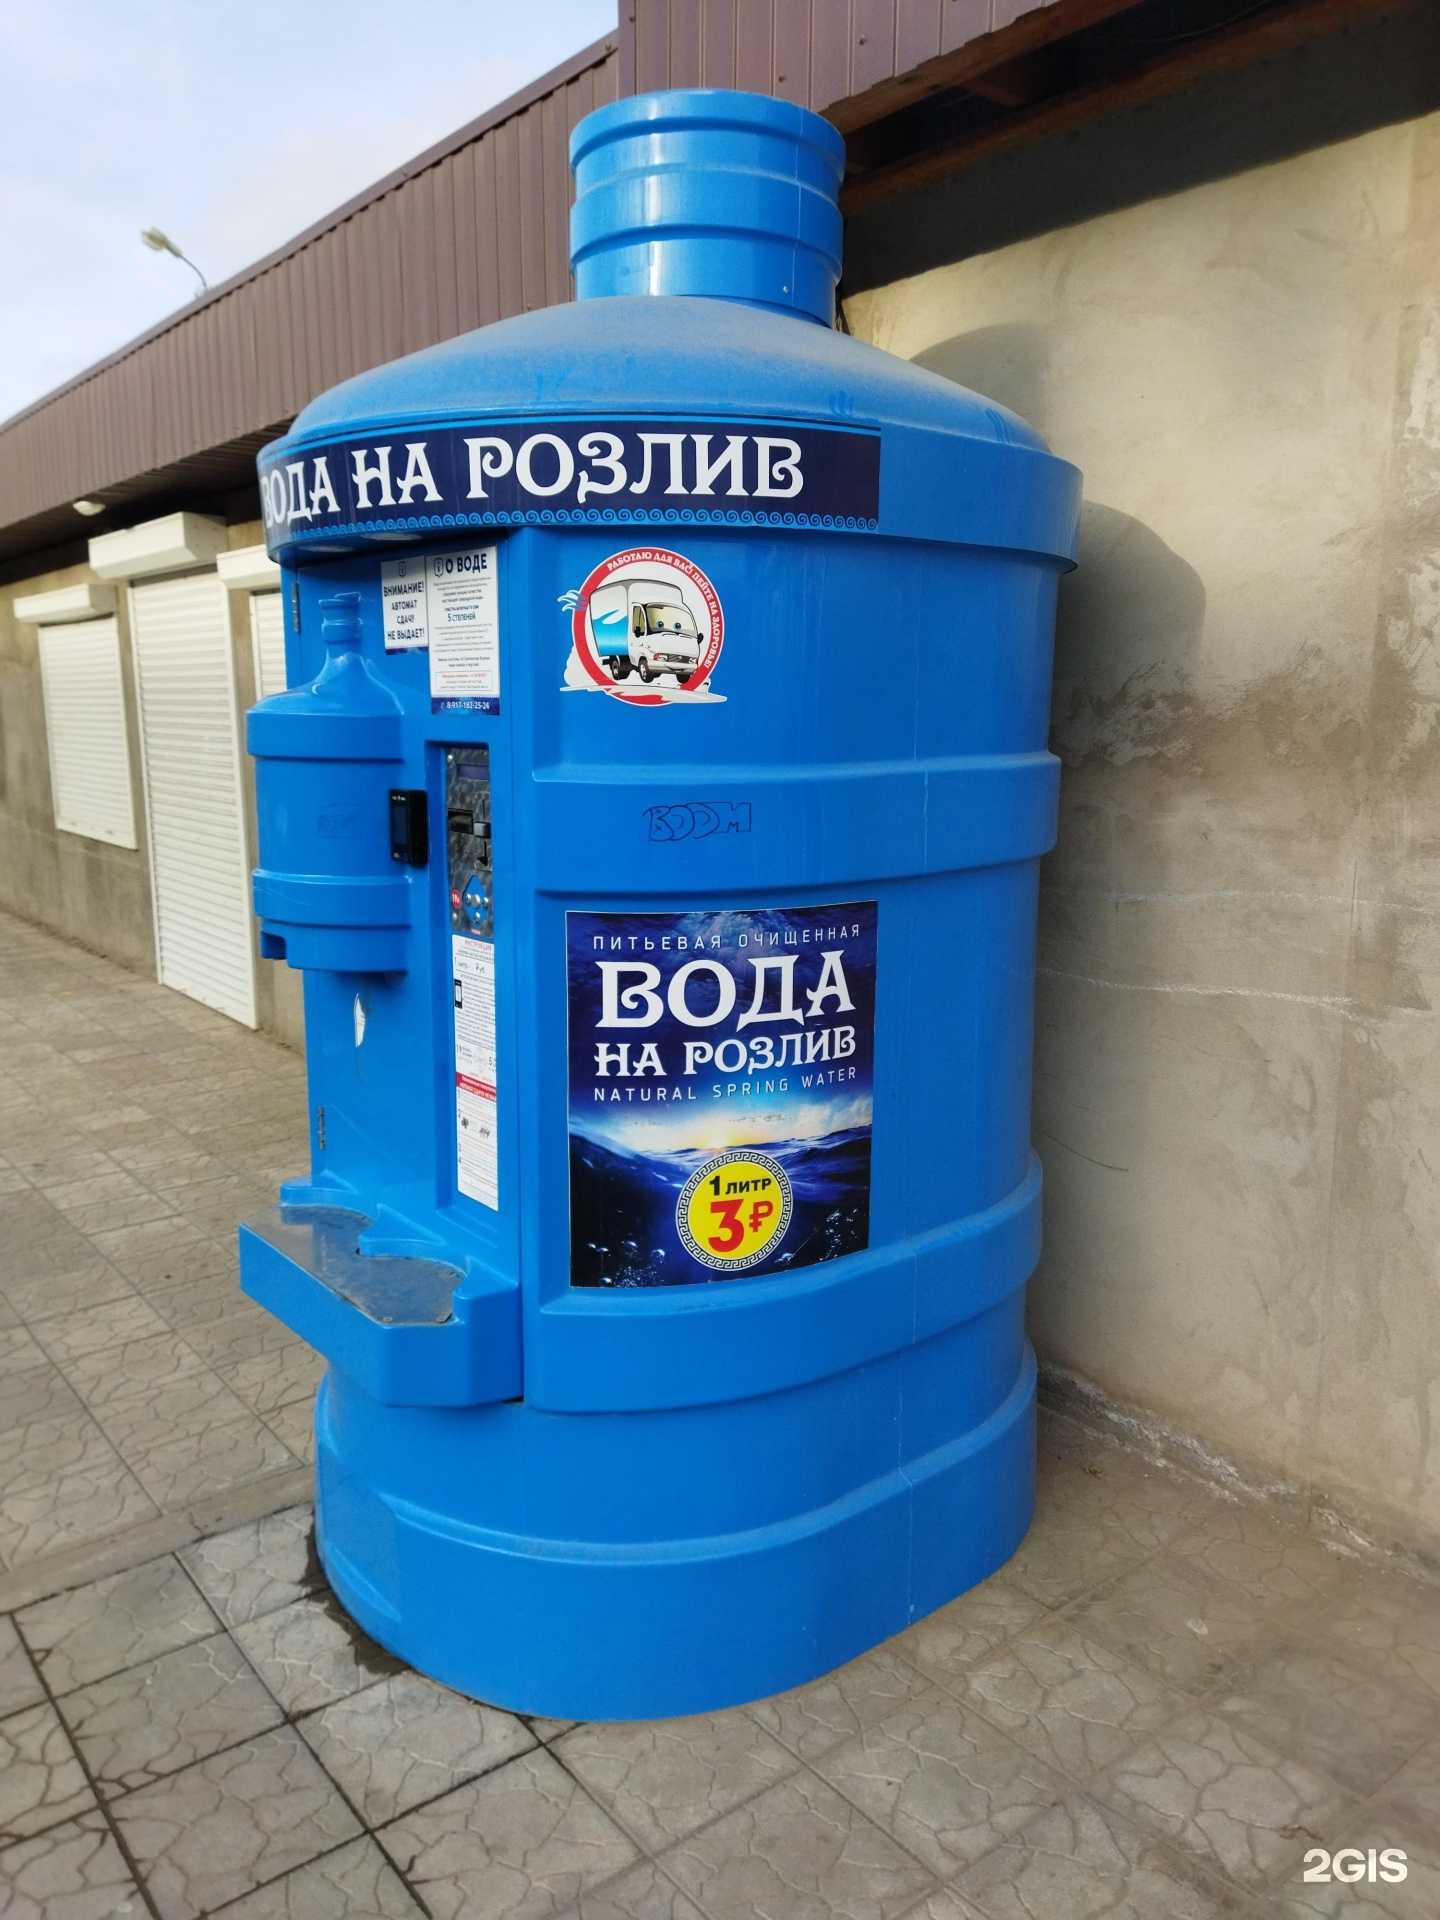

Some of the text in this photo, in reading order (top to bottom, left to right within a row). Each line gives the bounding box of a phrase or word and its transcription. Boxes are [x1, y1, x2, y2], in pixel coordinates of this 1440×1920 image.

[352, 442, 444, 509] НА
[464, 431, 805, 504] РОЗЛИВ
[445, 553, 488, 574] О ВОДЕ
[606, 551, 652, 572] РАБОТАЮ
[653, 552, 674, 563] ДЛЯ
[692, 570, 714, 600] ПЕЙТЕ
[383, 580, 425, 598] ВНИМАНИЕ!
[391, 599, 418, 611] АВТОМАТ
[396, 614, 415, 625] СДАЧУ
[387, 627, 425, 640] НЕ ВЫДАЕТ!
[593, 923, 861, 951] ПИТЬЕВАЯ ОЧИЩЕННАЯ
[594, 949, 857, 1033] ВОДА
[593, 1025, 857, 1077] НА РОЗЛИВ
[593, 1066, 857, 1102] NATURAL SPRING WATER
[709, 1176, 772, 1196] 1 ЛИТР
